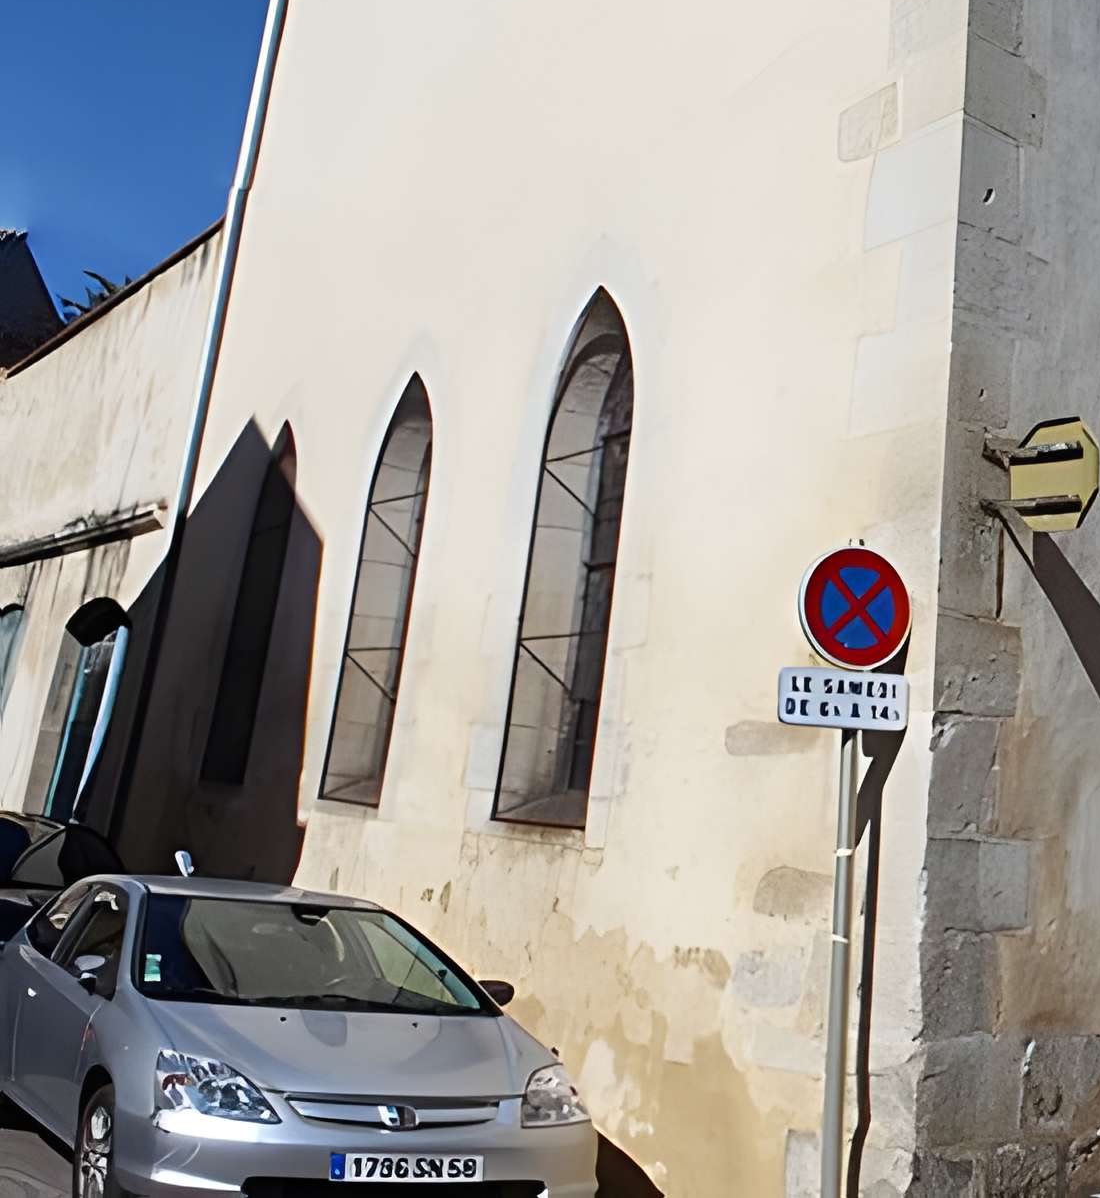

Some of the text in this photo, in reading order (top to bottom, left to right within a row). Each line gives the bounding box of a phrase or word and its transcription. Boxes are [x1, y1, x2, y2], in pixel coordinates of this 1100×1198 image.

[791, 676, 897, 699] LE SAMEDI
[785, 697, 810, 716] DE
